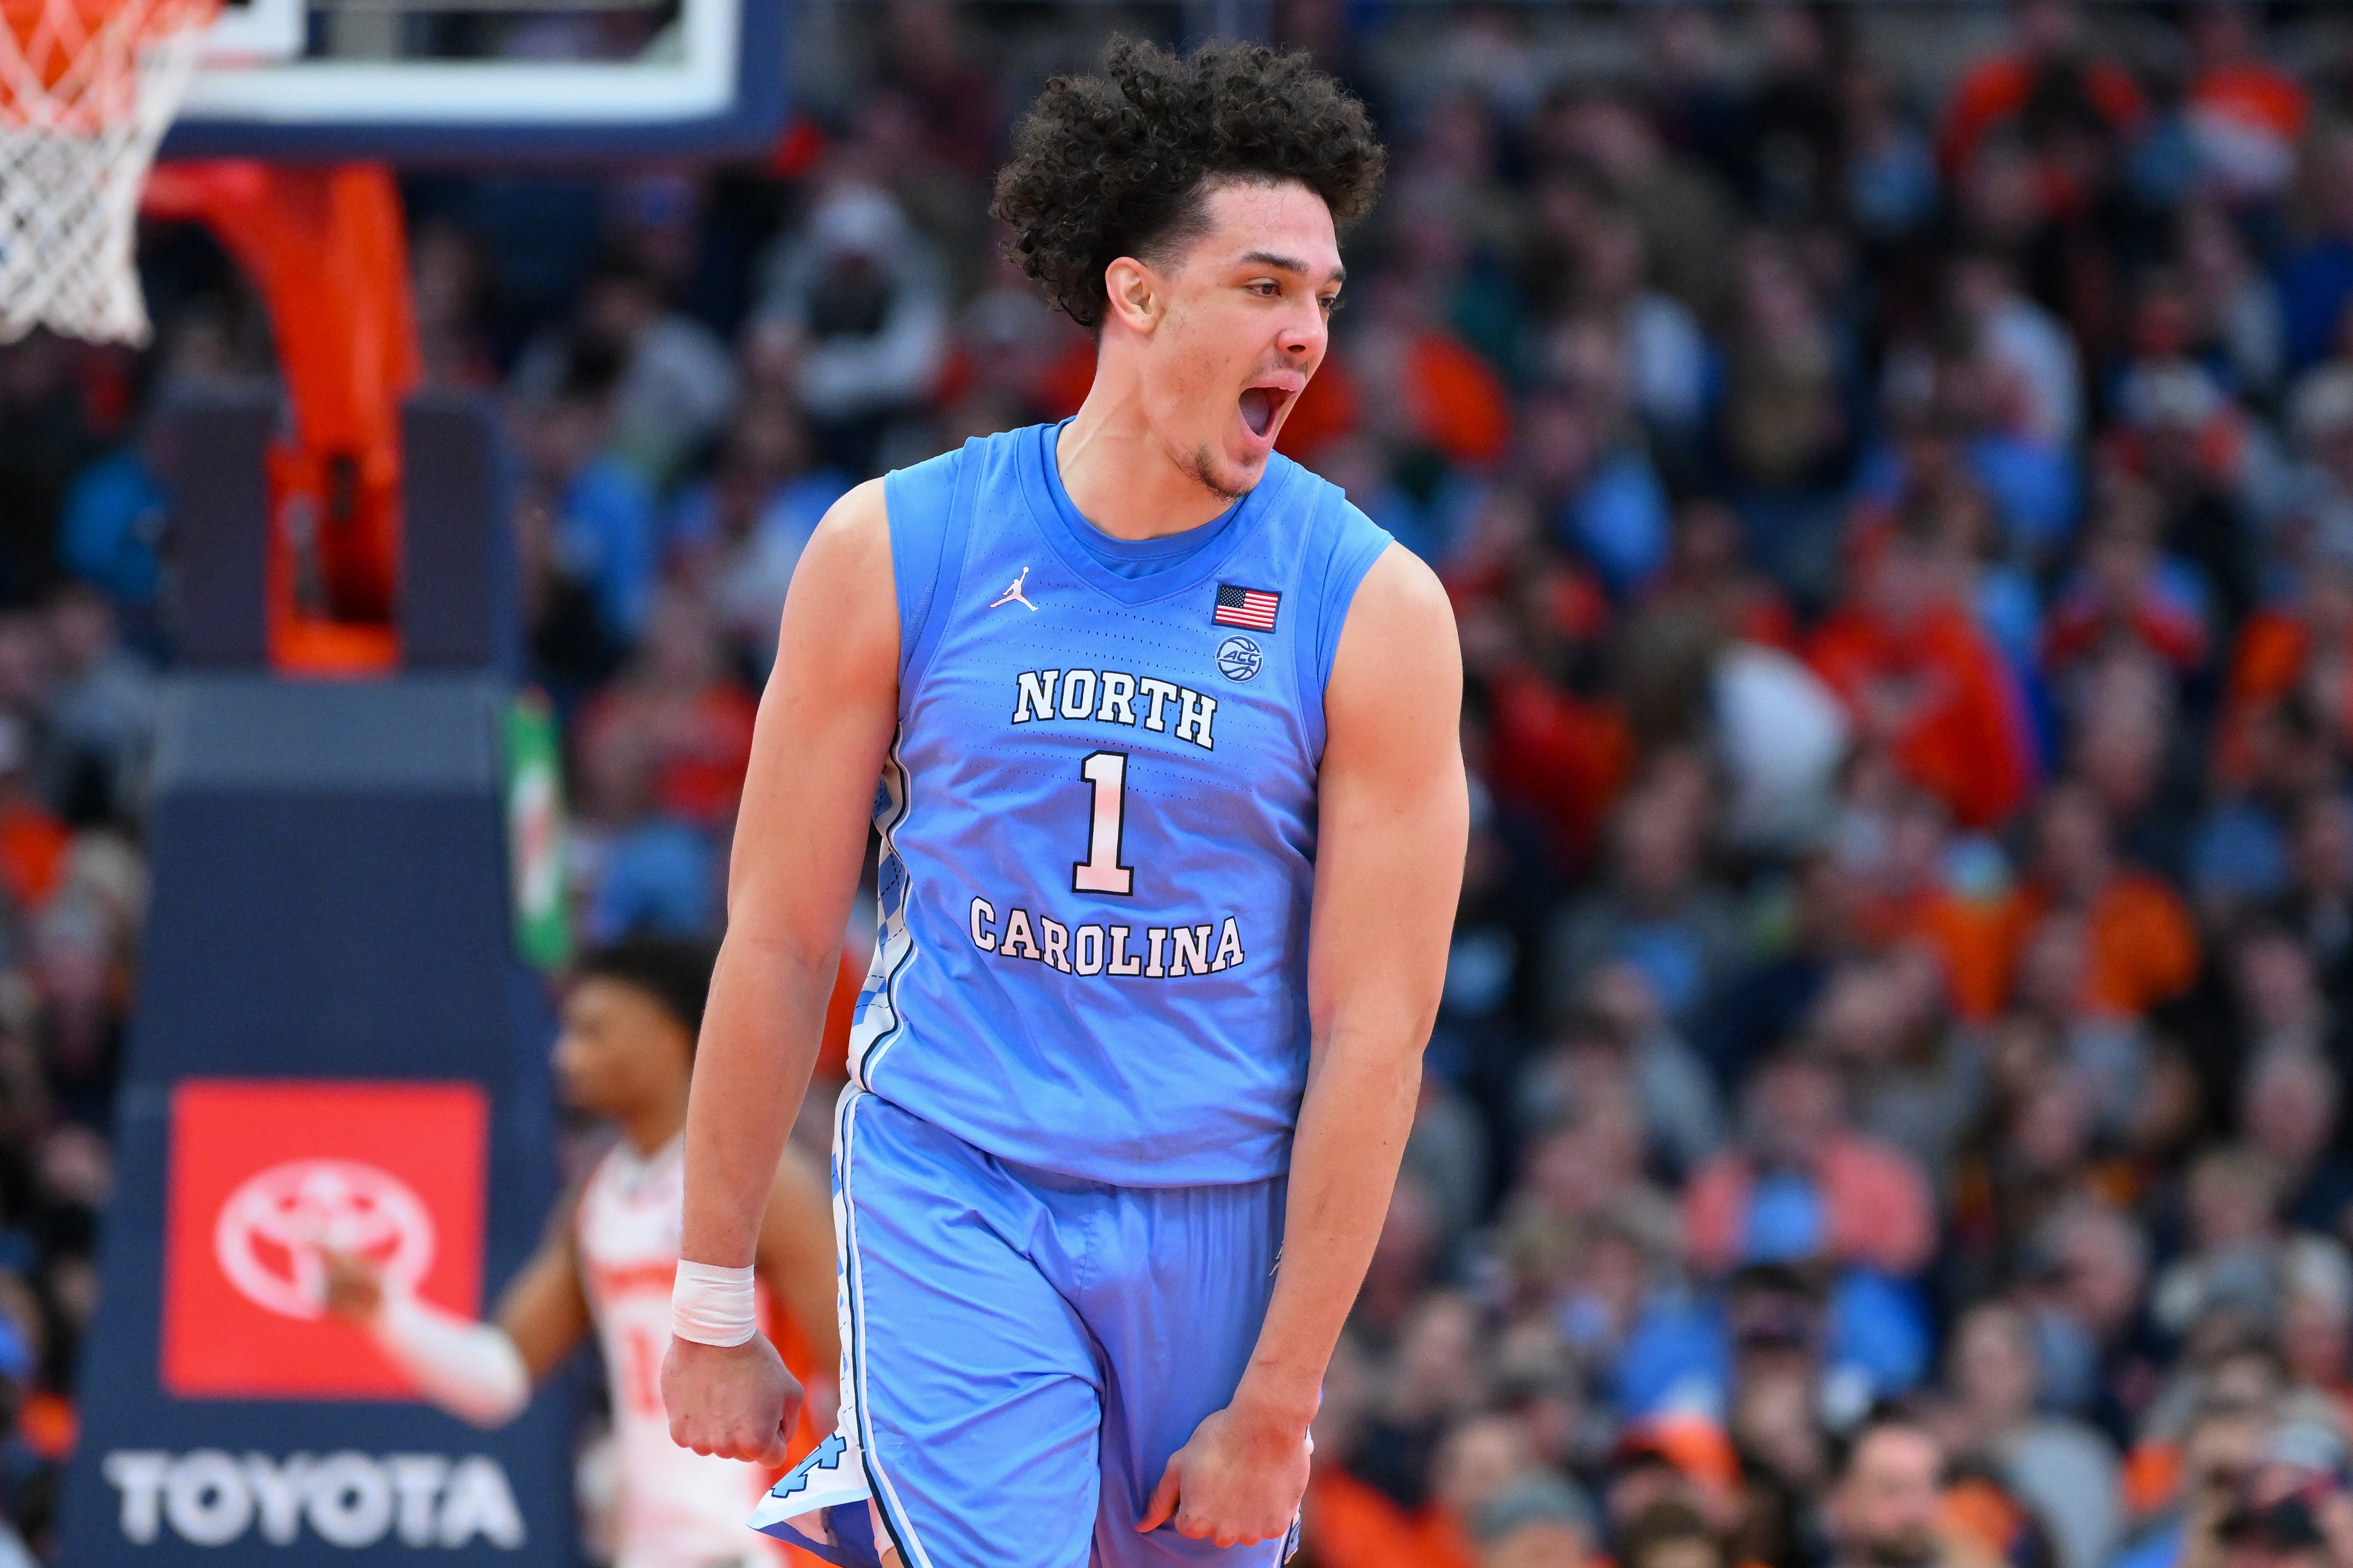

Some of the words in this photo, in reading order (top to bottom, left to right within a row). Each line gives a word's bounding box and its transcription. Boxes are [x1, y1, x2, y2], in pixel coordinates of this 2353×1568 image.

[1223, 650, 1261, 664] ACC
[1012, 668, 1218, 750] NORTH
[1072, 750, 1134, 895] 1
[970, 896, 1244, 978] CAROLINA
[105, 1451, 525, 1548] TOYOTA
